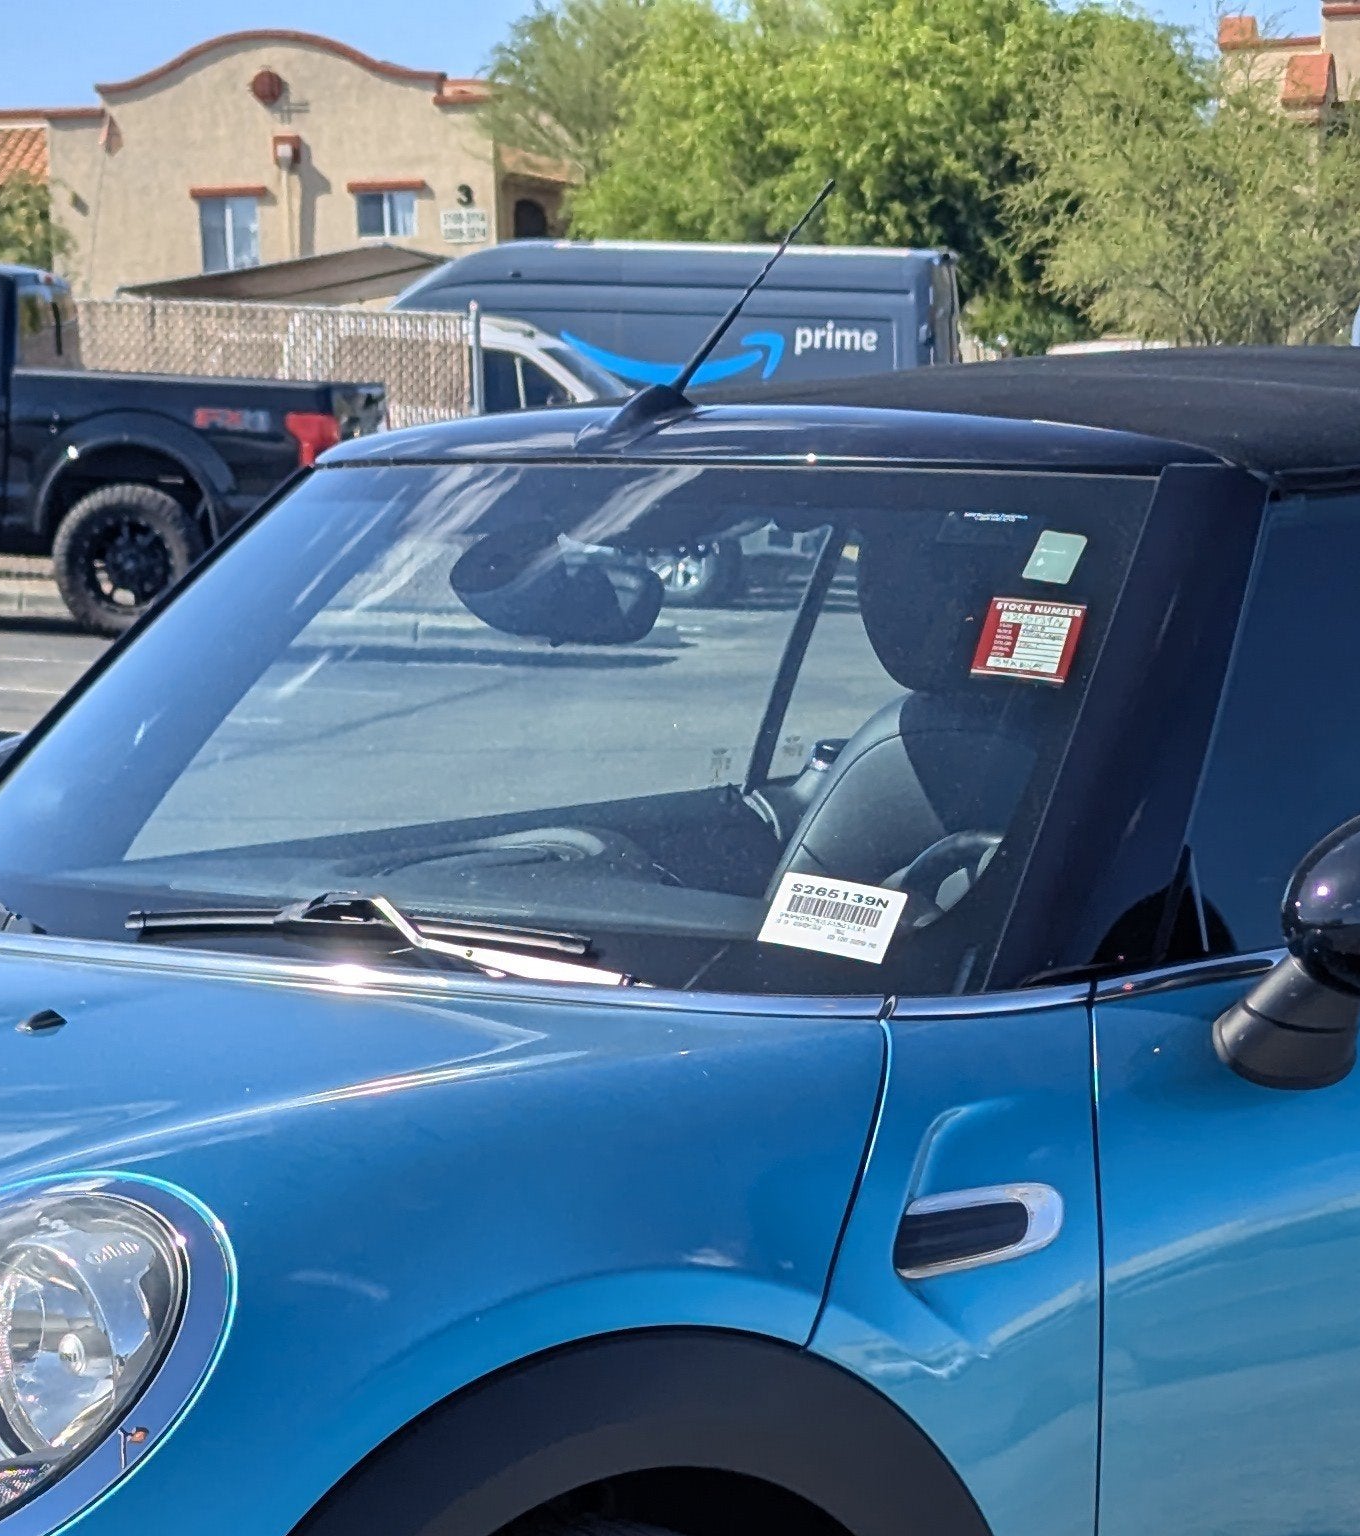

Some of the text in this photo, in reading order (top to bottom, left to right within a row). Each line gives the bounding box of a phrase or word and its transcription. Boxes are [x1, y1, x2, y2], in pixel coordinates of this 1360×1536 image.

[457, 184, 474, 206] 3
[794, 319, 879, 355] prime
[996, 601, 1082, 617] STOCK NUMBER
[790, 883, 890, 909] S265139N
